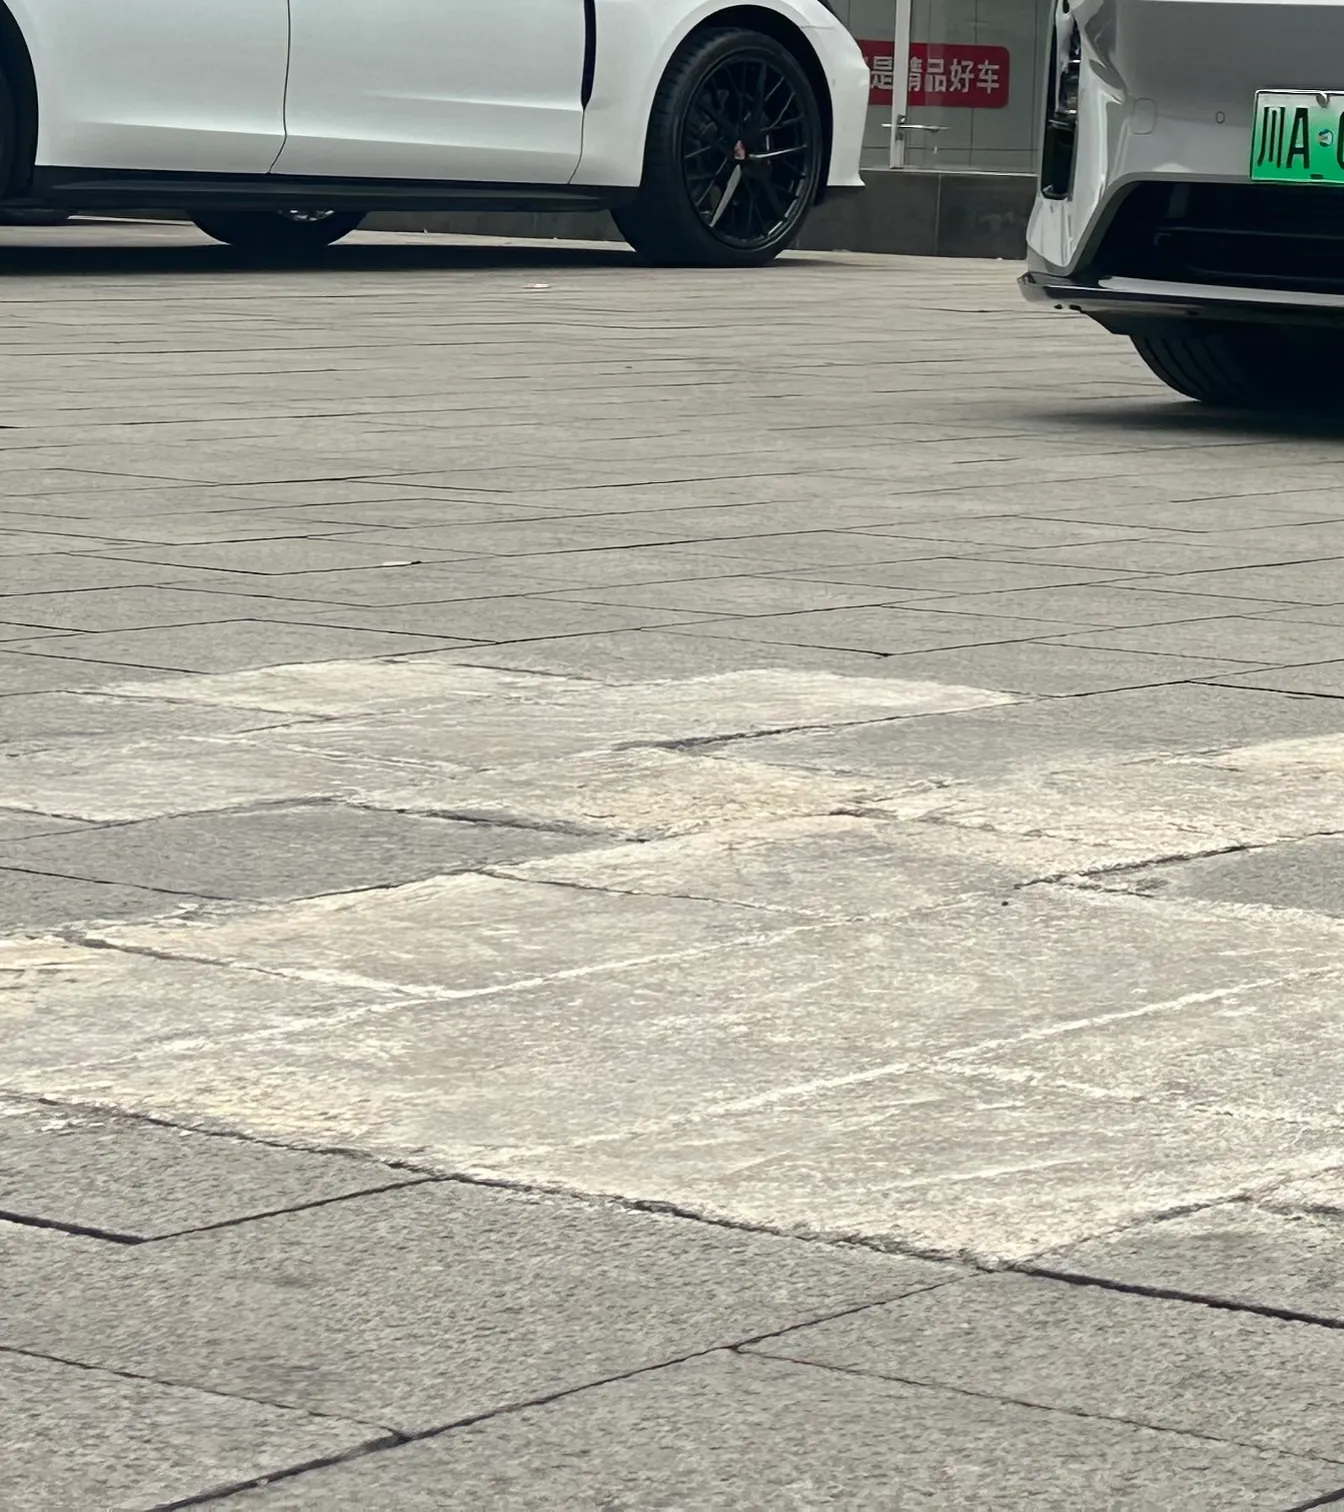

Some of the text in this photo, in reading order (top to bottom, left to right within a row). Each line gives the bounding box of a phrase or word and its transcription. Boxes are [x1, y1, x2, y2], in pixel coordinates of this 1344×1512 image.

[865, 55, 1000, 95] 是精品好车
